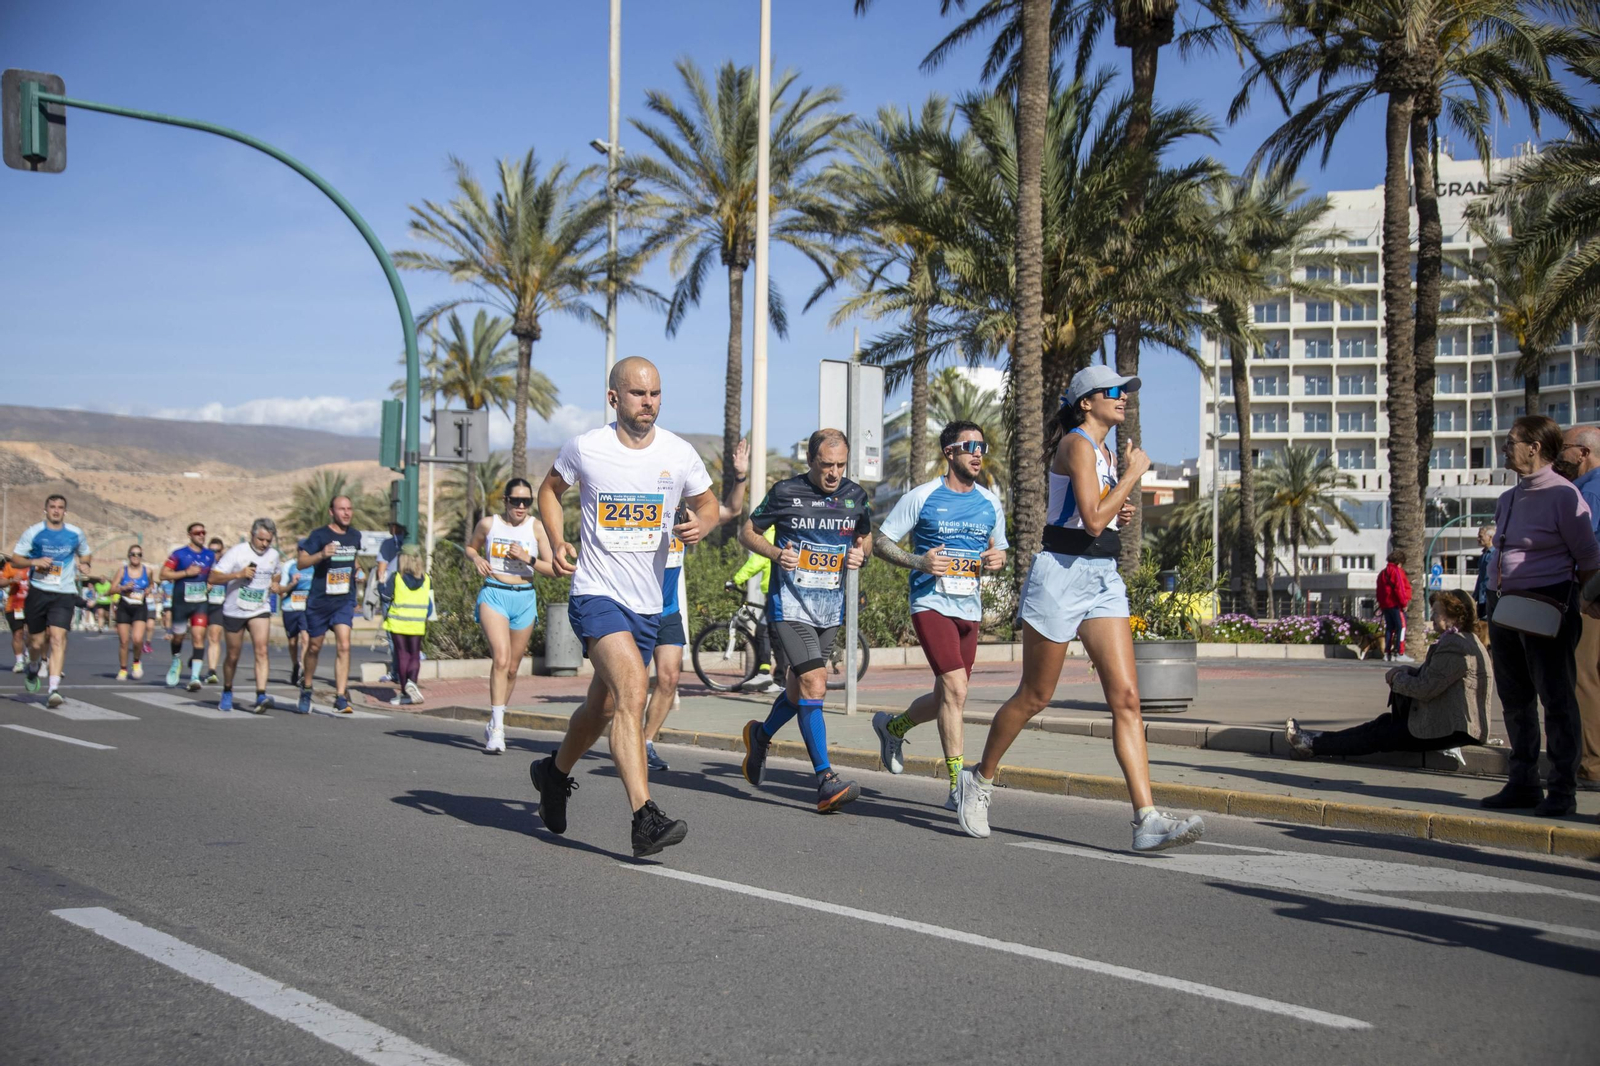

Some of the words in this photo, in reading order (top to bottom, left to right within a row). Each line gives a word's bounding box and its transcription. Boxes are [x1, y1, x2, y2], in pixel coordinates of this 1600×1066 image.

[604, 503, 658, 521] 2453
[791, 517, 815, 529] SAN
[818, 516, 856, 530] ANTÓN
[809, 552, 838, 568] 636
[951, 558, 977, 572] 326
